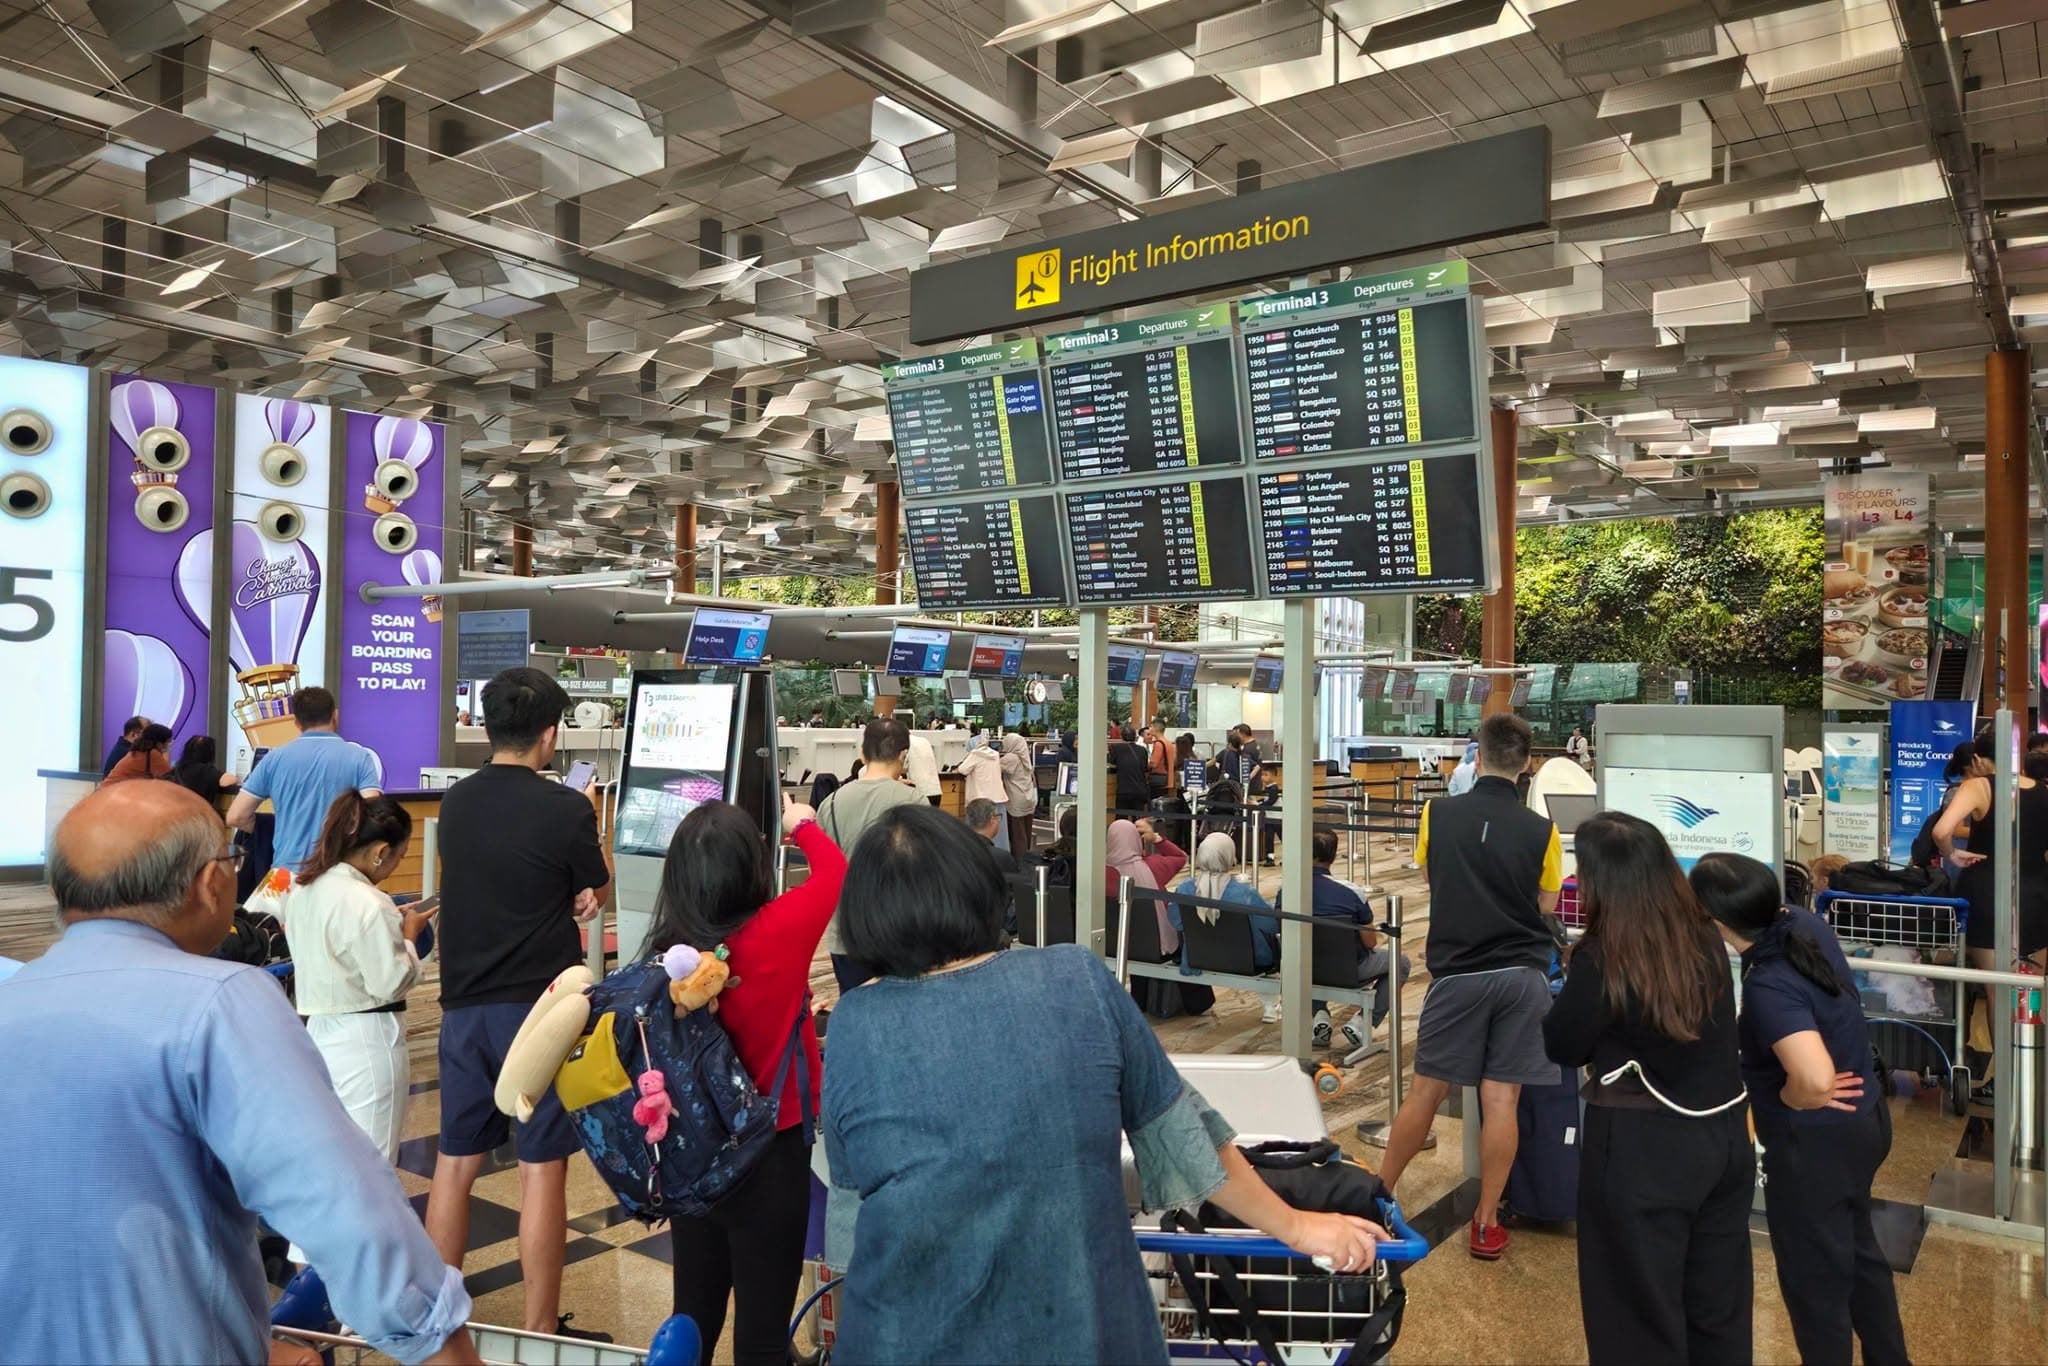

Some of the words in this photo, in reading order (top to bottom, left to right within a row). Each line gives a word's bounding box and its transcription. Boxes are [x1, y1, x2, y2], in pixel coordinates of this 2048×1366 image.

[1069, 249, 1138, 286] Flight
[1146, 215, 1309, 268] Information
[1256, 292, 1318, 316] Terminal
[1320, 291, 1329, 304] 3
[1354, 278, 1414, 298] Departures
[1359, 301, 1376, 309] Flight
[1426, 289, 1454, 298] Remarks
[1058, 331, 1109, 349] Terminal
[1111, 328, 1119, 340] 3
[1139, 319, 1188, 335] Departures
[1247, 335, 1264, 344] 1950
[1293, 323, 1339, 336] Christchurch
[1361, 318, 1371, 326] TK
[1248, 347, 1265, 355] 1950
[1294, 336, 1336, 350] Guangzhou
[1377, 326, 1397, 336] 1346
[1249, 358, 1266, 366] 1955
[1295, 352, 1309, 360] San
[1310, 347, 1344, 358] Francisco
[1362, 342, 1374, 351] SQ
[1377, 340, 1388, 348] 34
[895, 360, 936, 377] Terminal
[938, 359, 945, 370] 3
[961, 351, 1002, 366] Departures
[1250, 370, 1267, 378] 2000
[1269, 367, 1284, 375] GULF
[1296, 362, 1324, 371] Bahrain
[1379, 352, 1394, 360] 166
[1251, 381, 1268, 389] 2000
[1297, 372, 1337, 385] Hyderabad
[1364, 366, 1377, 374] NH
[1018, 384, 1034, 393] Open
[1252, 392, 1269, 400] 2000
[1298, 386, 1319, 395] Kochi
[1365, 379, 1377, 387] SQ
[1380, 376, 1395, 384] 534
[1020, 394, 1035, 403] Open
[1253, 404, 1270, 412] 2005
[1299, 396, 1336, 408] Bengaluru
[1366, 391, 1377, 399] SQ
[1381, 388, 1396, 396] 510
[1021, 404, 1037, 413] Open
[1254, 415, 1271, 423] 2005
[1300, 407, 1341, 419] Chongqing
[1382, 400, 1402, 408] 5255
[1255, 426, 1272, 434] 2010
[1301, 420, 1334, 429] Colombo
[1383, 412, 1403, 420] 6013
[1302, 431, 1332, 440] Chennai
[1368, 426, 1380, 434] SQ
[1384, 424, 1399, 432] 528
[1303, 443, 1331, 452] Kolkata
[1259, 476, 1277, 484] 2045
[1305, 471, 1332, 481] Sydney
[1387, 464, 1407, 472] 9780
[1320, 481, 1350, 491] Angeles
[1372, 478, 1385, 486] SQ
[1307, 493, 1342, 501] Shenzhen
[1838, 488, 1893, 501] DISCOVER
[1857, 497, 1917, 509] FLAVOURS
[1355, 513, 1371, 522] City
[1862, 511, 1880, 523] L3
[1894, 509, 1913, 521] L4
[246, 555, 297, 578] Changi
[1314, 569, 1366, 577] Seoul-Incheon
[257, 569, 302, 589] Shopping
[236, 570, 320, 607] Carnival
[0, 566, 55, 642] 5
[371, 614, 415, 628] SCAN
[371, 630, 414, 643] YOUR
[695, 636, 709, 644] Help
[351, 645, 432, 660] BOARDING
[371, 661, 413, 675] PASS
[357, 677, 380, 690] TO
[382, 678, 426, 691] PLAY!
[582, 680, 607, 689] BAGGAGE
[1897, 742, 1931, 750] Introducing
[1897, 750, 1923, 760] Piece
[1925, 750, 1954, 761] Conce
[1897, 759, 1927, 768] Baggage
[1681, 832, 1727, 845] Indonesia
